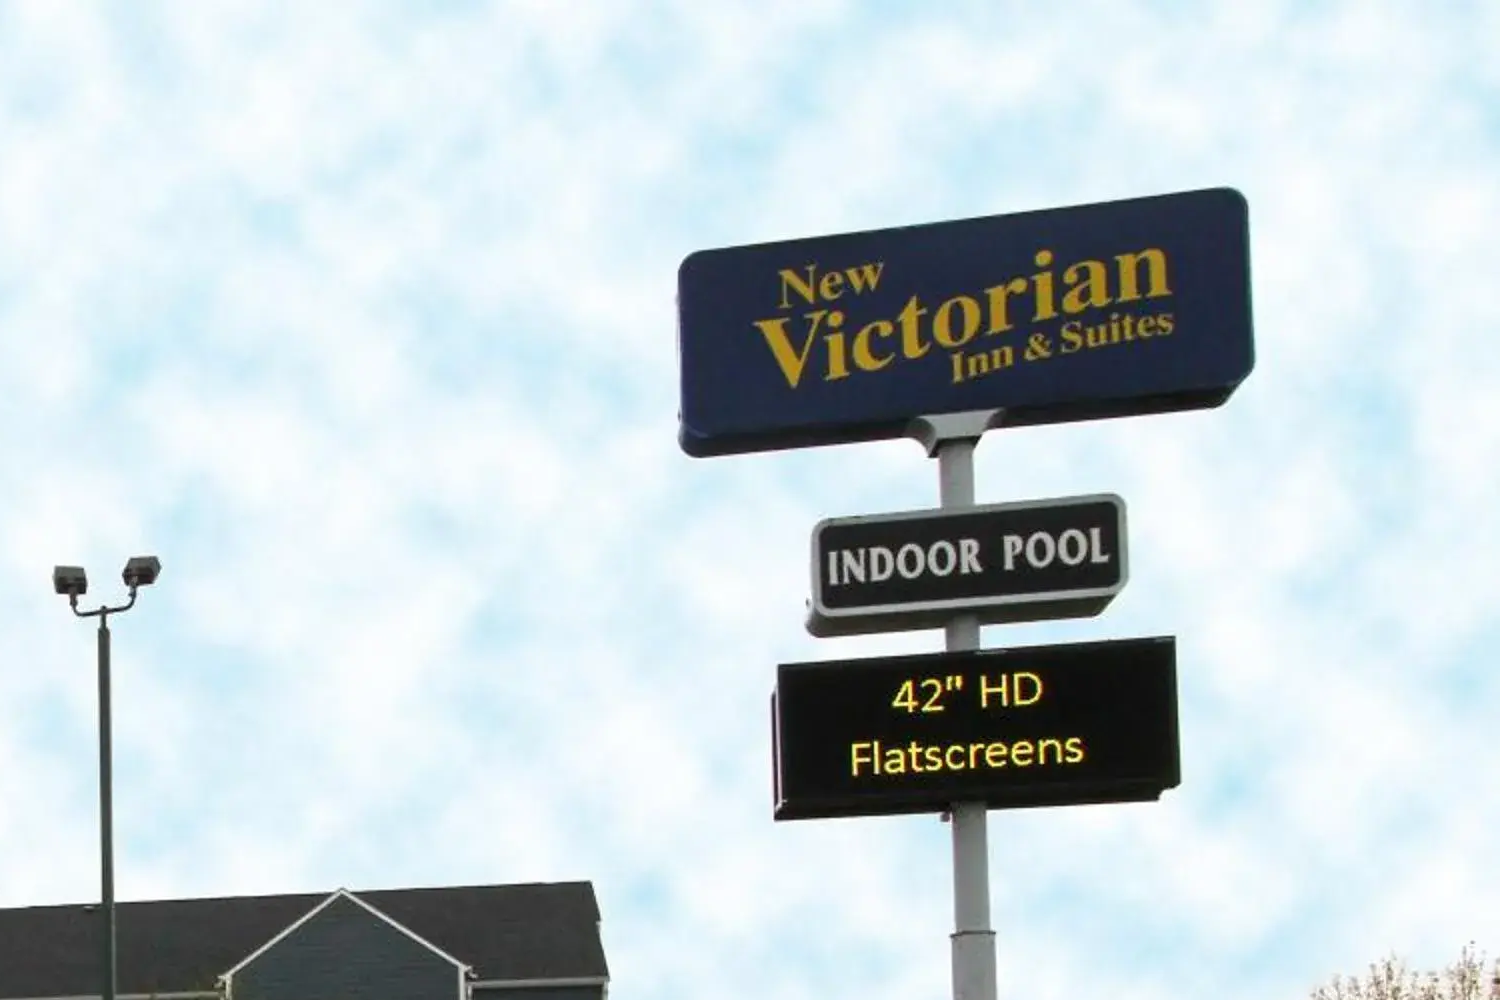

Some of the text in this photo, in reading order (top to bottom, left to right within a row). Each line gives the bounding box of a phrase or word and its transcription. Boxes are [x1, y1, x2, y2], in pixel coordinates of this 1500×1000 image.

[778, 261, 884, 308] New
[754, 247, 1173, 388] Victorian
[951, 311, 1175, 384] Inn & Suites
[827, 527, 1110, 586] INDOOR POOL
[891, 671, 1044, 714] 42" HD
[850, 736, 1086, 777] Flatscreens
